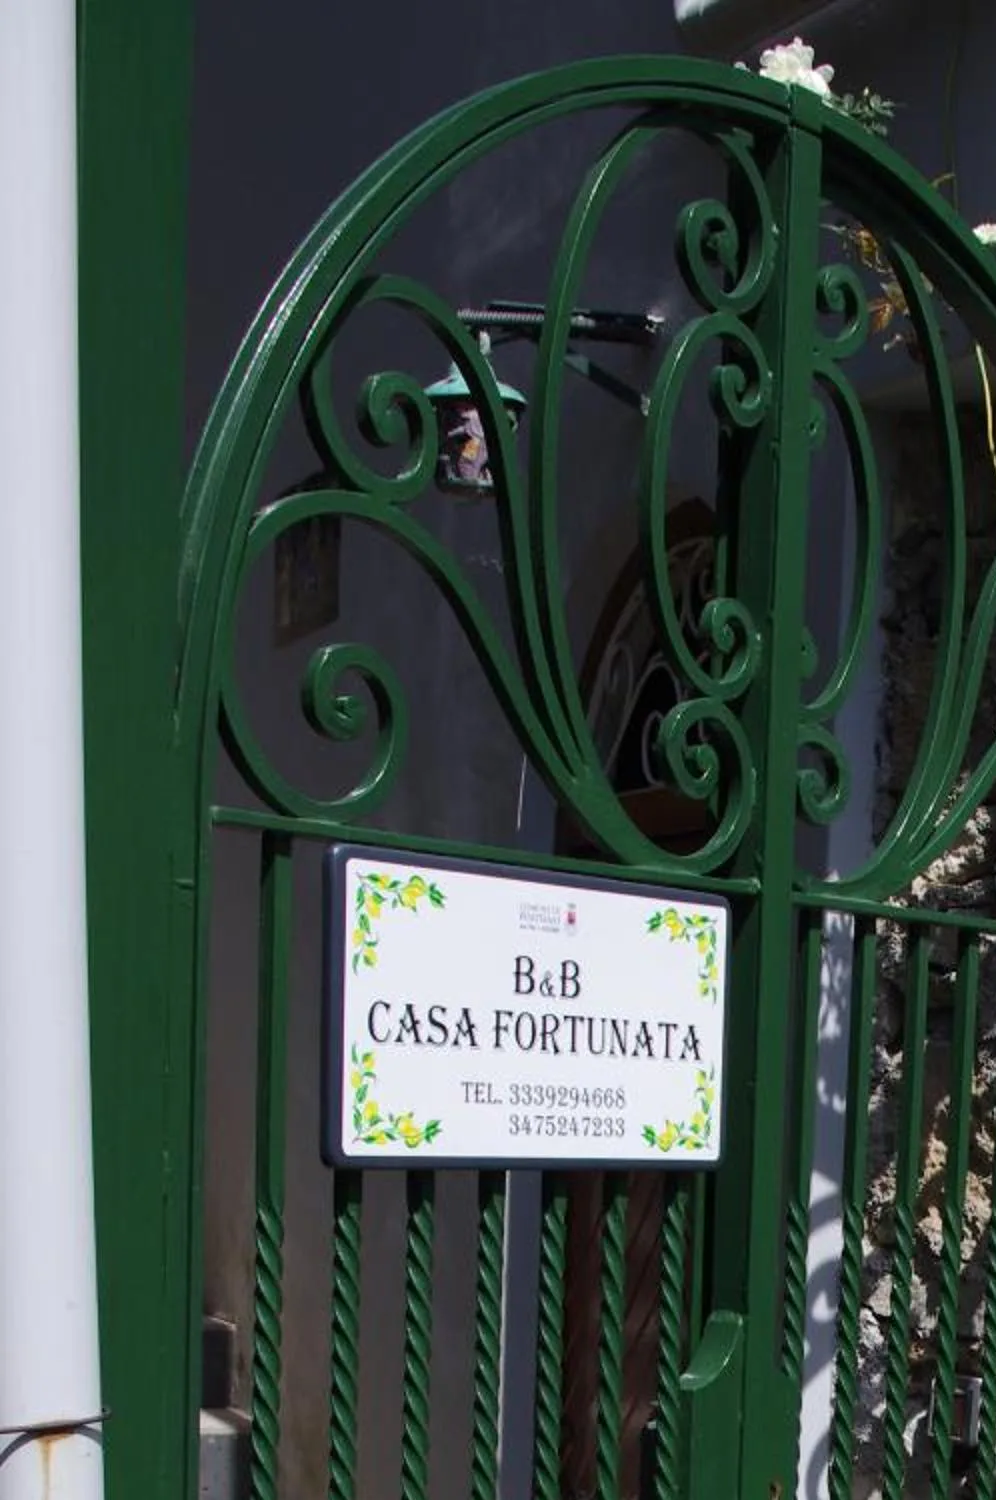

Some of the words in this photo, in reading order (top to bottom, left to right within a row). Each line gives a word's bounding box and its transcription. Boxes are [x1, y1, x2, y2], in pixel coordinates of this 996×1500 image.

[513, 955, 582, 999] B&B
[367, 1000, 479, 1048] CASA
[493, 1009, 702, 1061] FORTUNATA
[461, 1081, 503, 1105] TEL.
[508, 1083, 627, 1110] 3339294668
[508, 1114, 626, 1138] 3475247233
